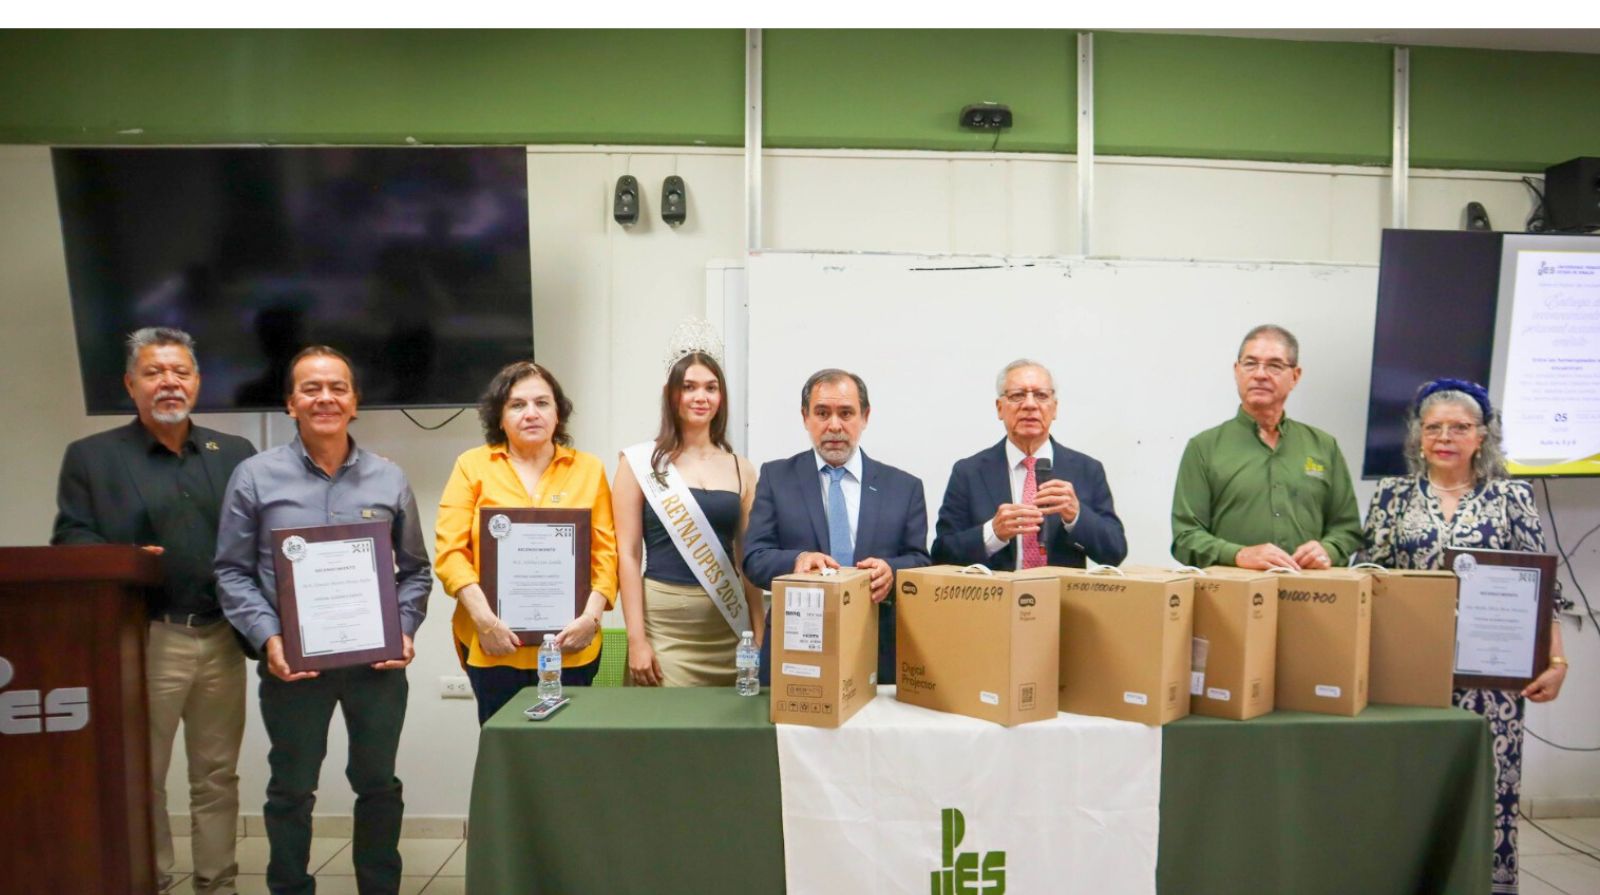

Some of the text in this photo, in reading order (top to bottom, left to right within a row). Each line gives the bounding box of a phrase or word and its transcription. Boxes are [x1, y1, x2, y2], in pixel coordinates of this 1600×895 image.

[661, 493, 743, 619] REYNA UPES 2025
[902, 662, 926, 677] Digital
[902, 677, 937, 691] Projector
